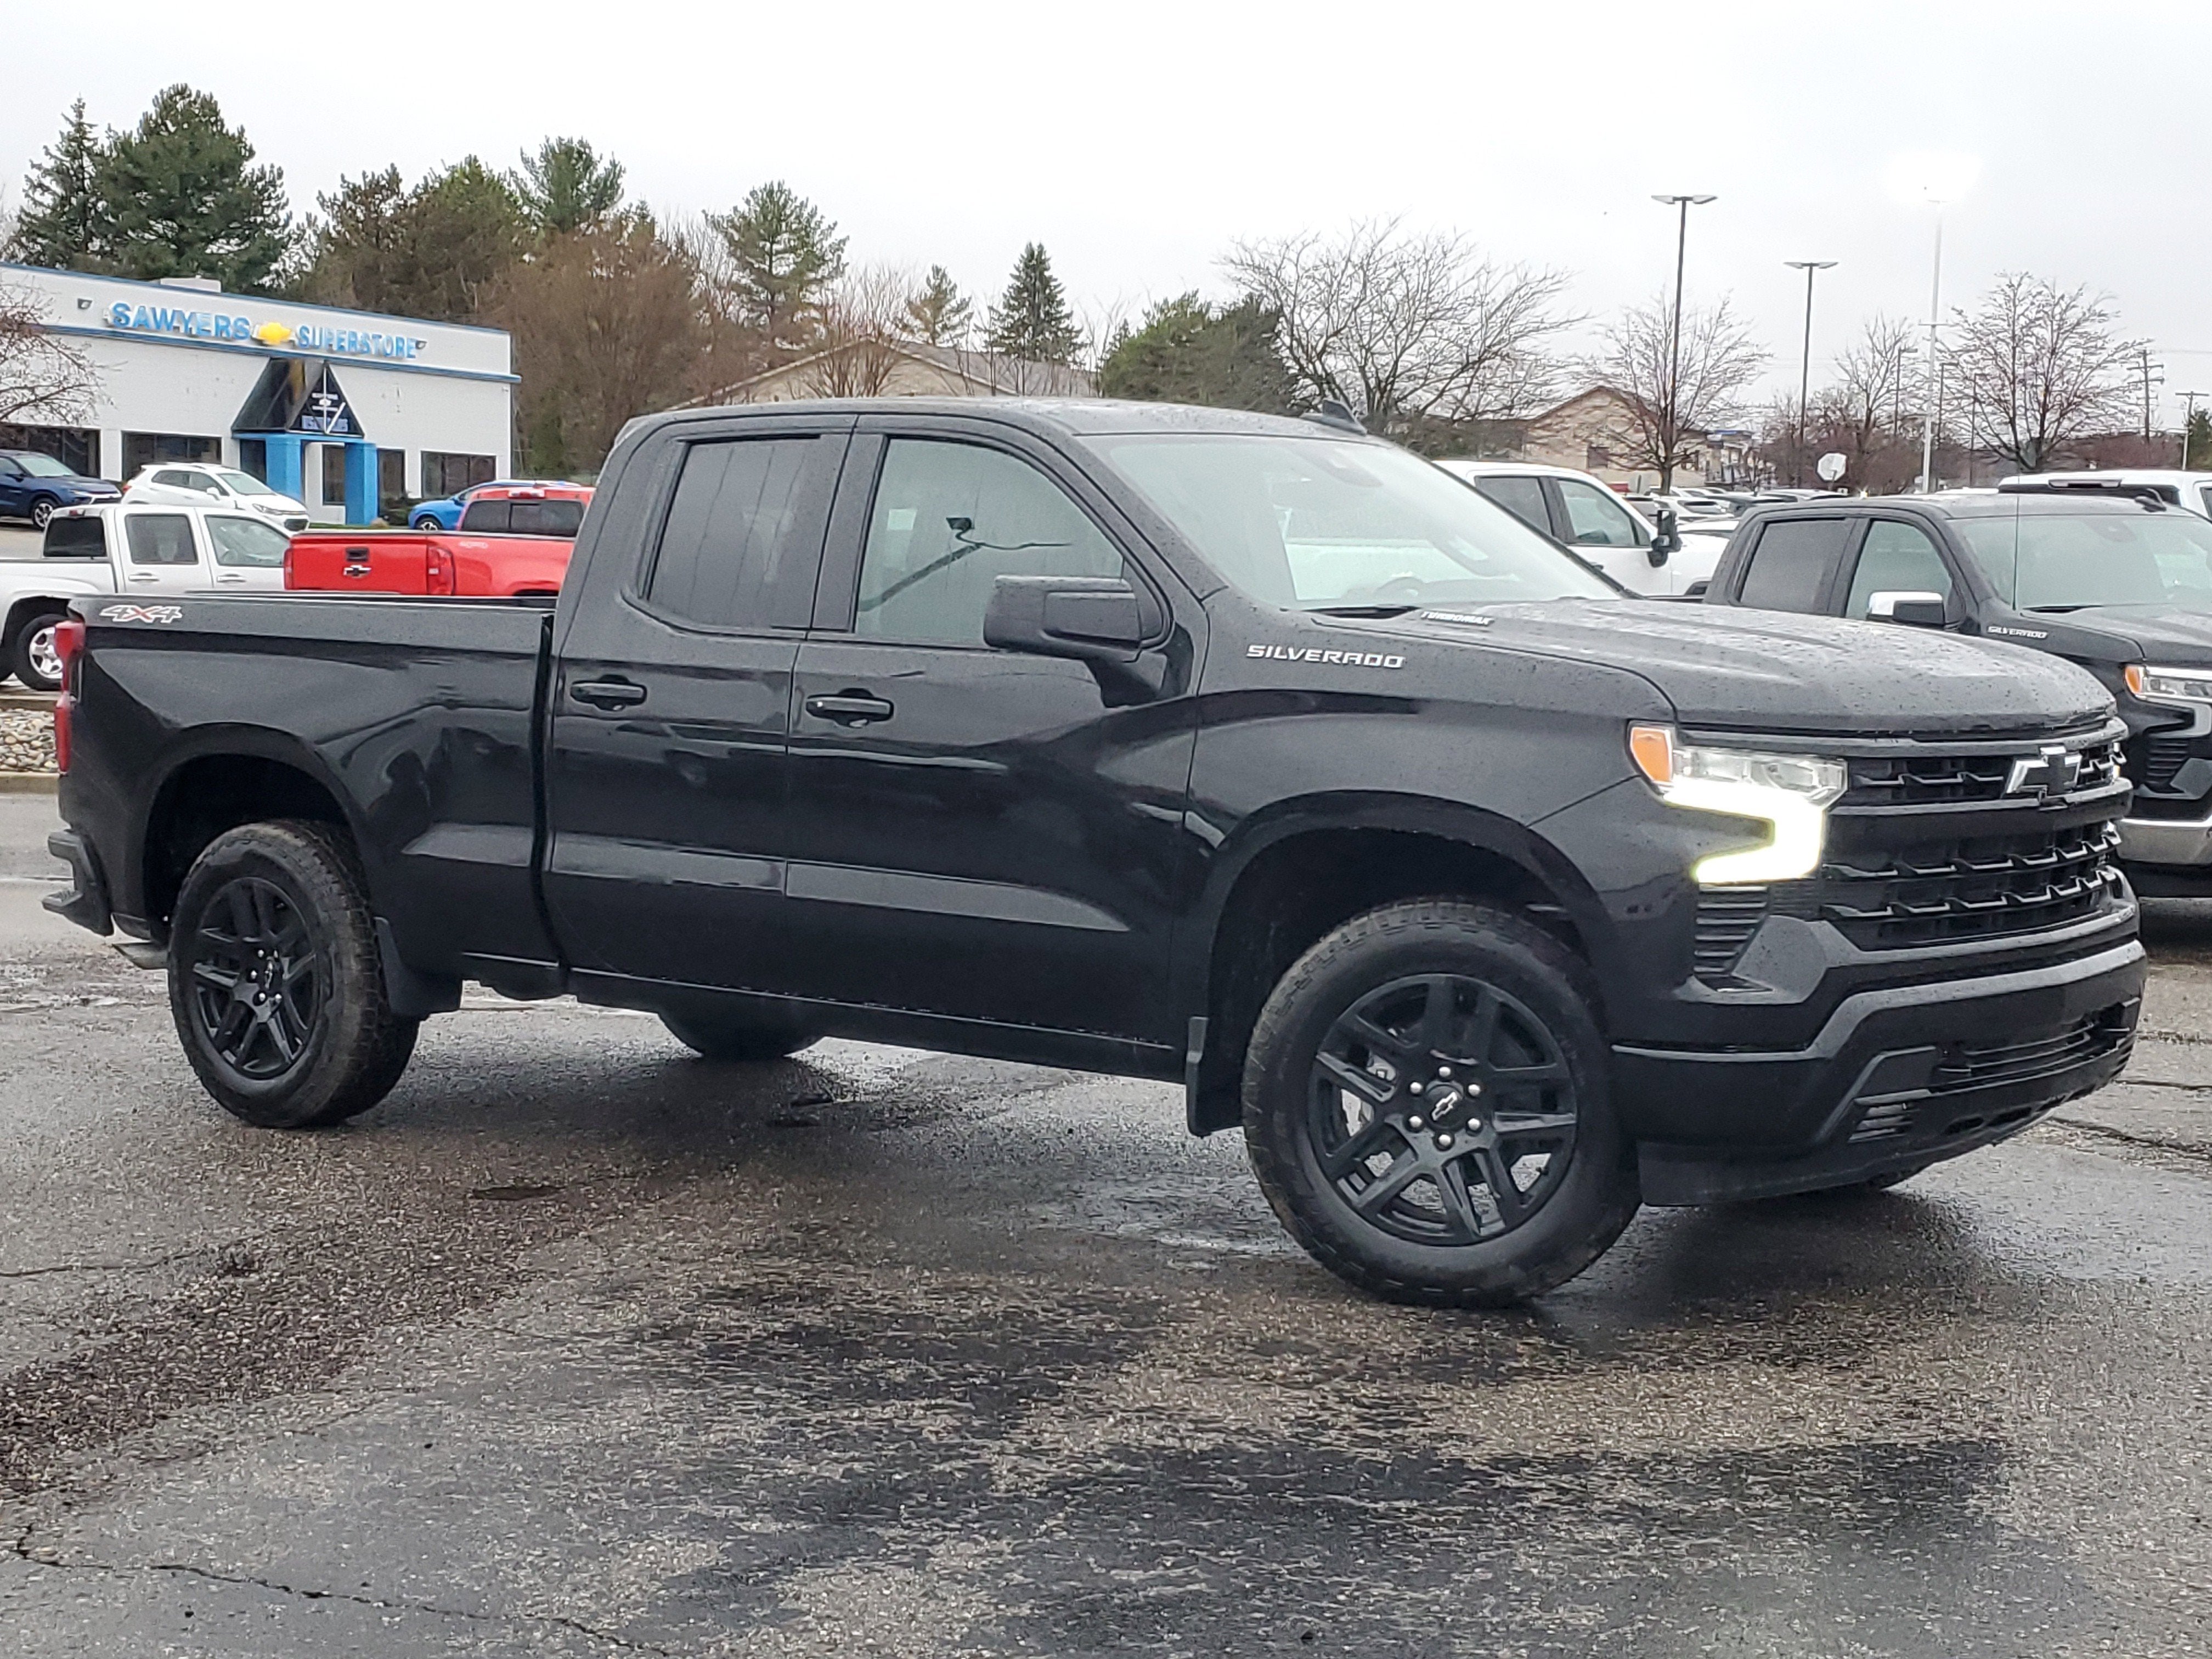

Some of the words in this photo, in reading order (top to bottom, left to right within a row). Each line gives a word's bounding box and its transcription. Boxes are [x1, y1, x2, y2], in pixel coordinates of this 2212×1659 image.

[111, 301, 250, 340] SAWYERS
[297, 325, 416, 358] SUPERSTORE
[1246, 645, 1406, 669] SILVERADO
